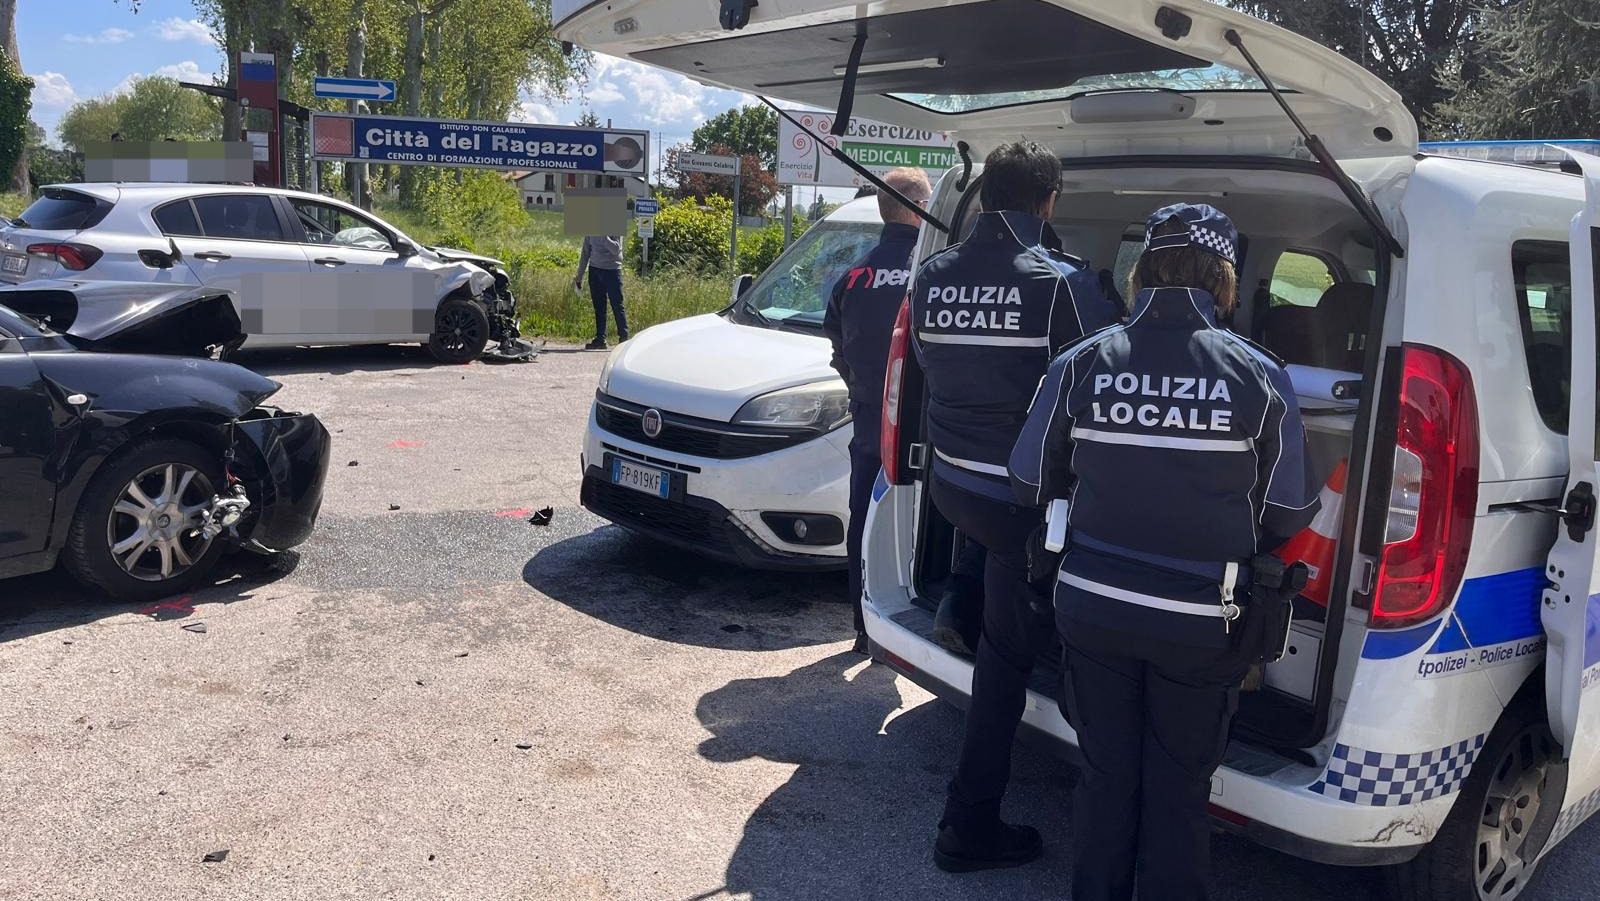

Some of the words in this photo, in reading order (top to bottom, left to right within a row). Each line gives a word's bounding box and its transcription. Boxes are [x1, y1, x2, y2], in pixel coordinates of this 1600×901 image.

[440, 123, 470, 131] ISTITUTO
[846, 118, 933, 141] Esercizio
[366, 128, 430, 148] Città
[441, 132, 480, 151] del
[491, 134, 598, 157] Ragazzo
[387, 152, 424, 161] CENTRO
[440, 154, 504, 165] FORMAZIONE
[507, 158, 578, 169] PROFESSIONALE
[713, 161, 734, 169] Calabria
[780, 161, 813, 170] Esercizio
[845, 148, 912, 165] MEDICAL
[797, 171, 813, 179] Vita
[927, 286, 1022, 305] POLIZIA
[925, 309, 1021, 330] LOCALE
[1094, 372, 1232, 402] POLIZIA
[1092, 402, 1233, 432] LOCALE
[1418, 653, 1469, 677] tpolizei
[1479, 647, 1513, 664] Police
